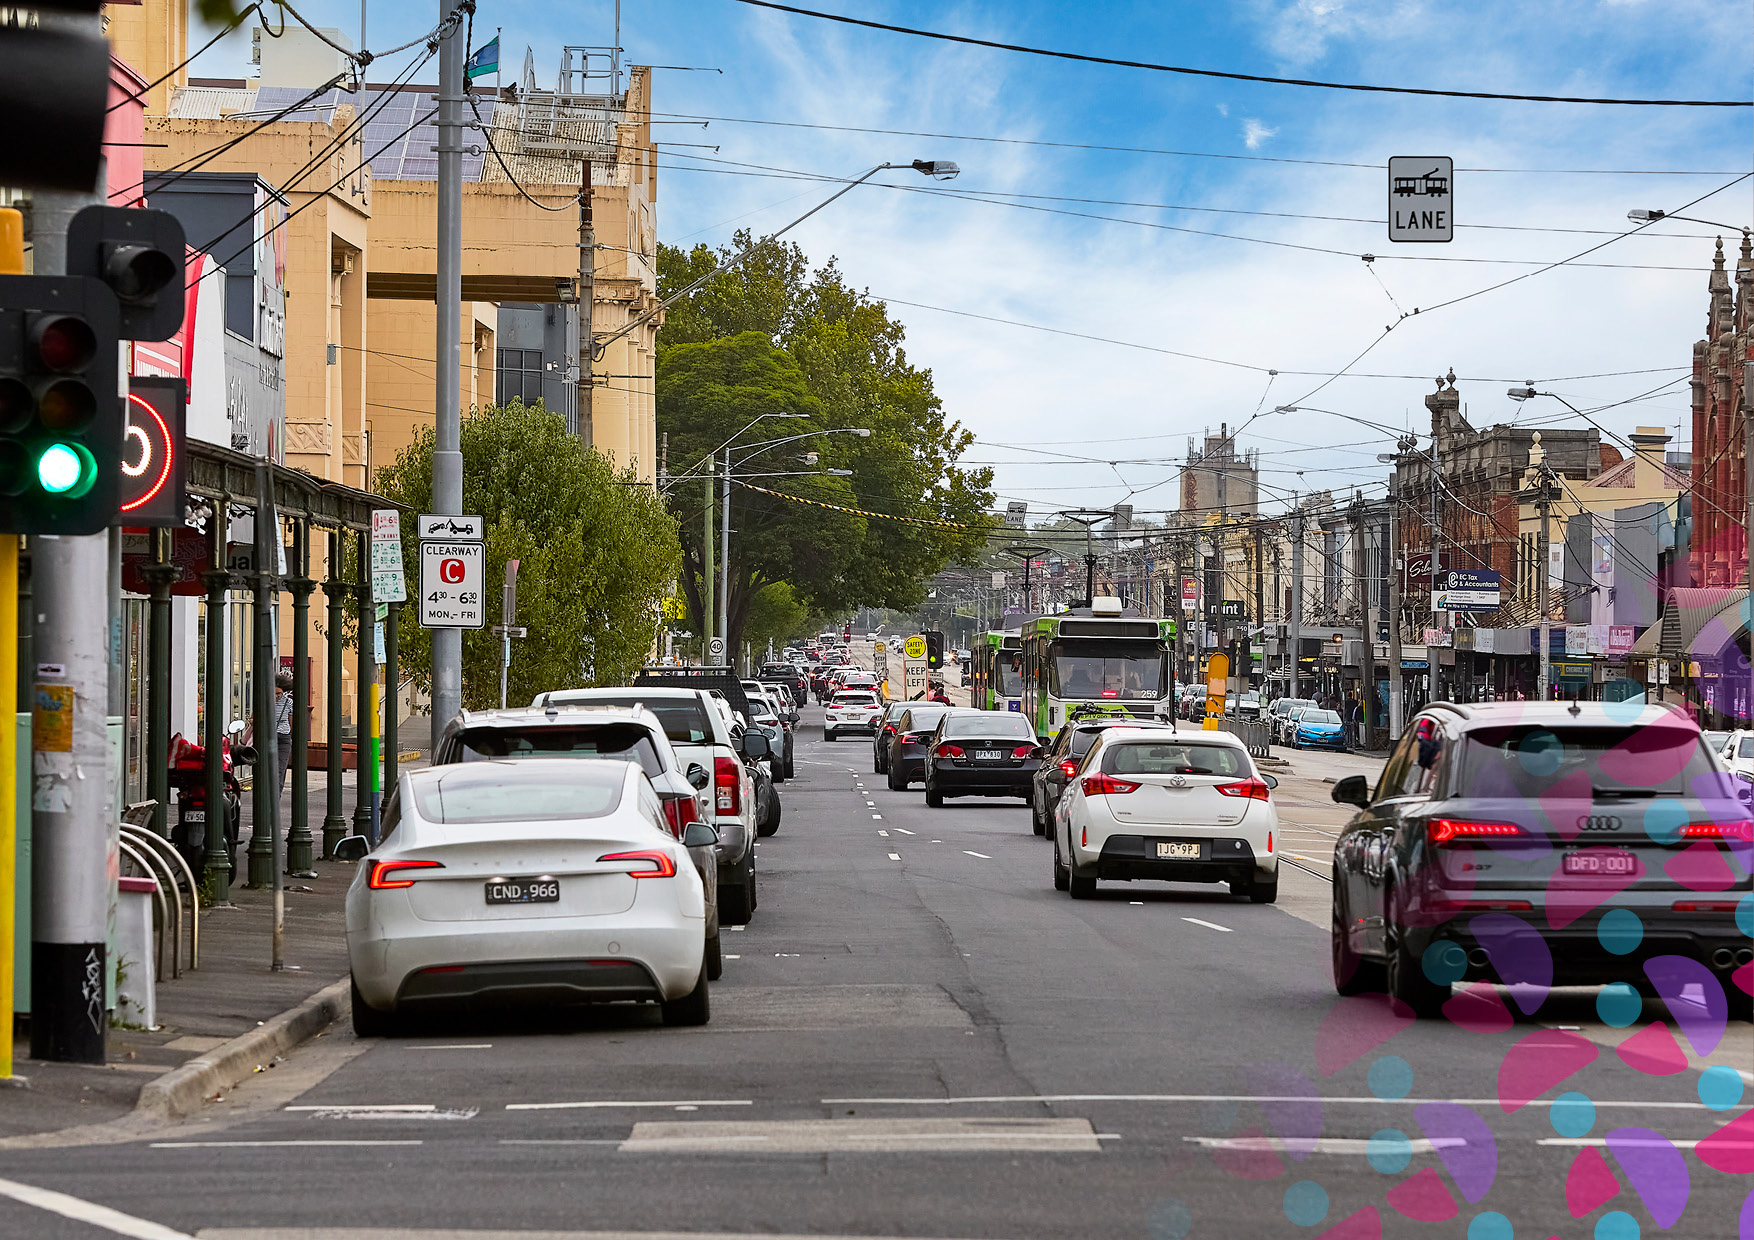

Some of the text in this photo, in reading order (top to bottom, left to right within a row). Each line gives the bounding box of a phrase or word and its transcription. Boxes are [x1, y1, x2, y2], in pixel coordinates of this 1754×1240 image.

[1396, 210, 1446, 230] LANE
[1006, 515, 1024, 523] LANE
[426, 546, 479, 556] CLEARWAY
[445, 560, 460, 582] C
[1210, 600, 1239, 615] mint
[461, 611, 476, 619] FRI
[906, 667, 926, 675] KEEP
[907, 679, 926, 687] LEFT
[1141, 690, 1158, 699] 259
[1181, 844, 1199, 855] 9PJ
[1571, 857, 1633, 871] DFD 001
[493, 884, 521, 899] CND
[529, 883, 558, 898] 966
